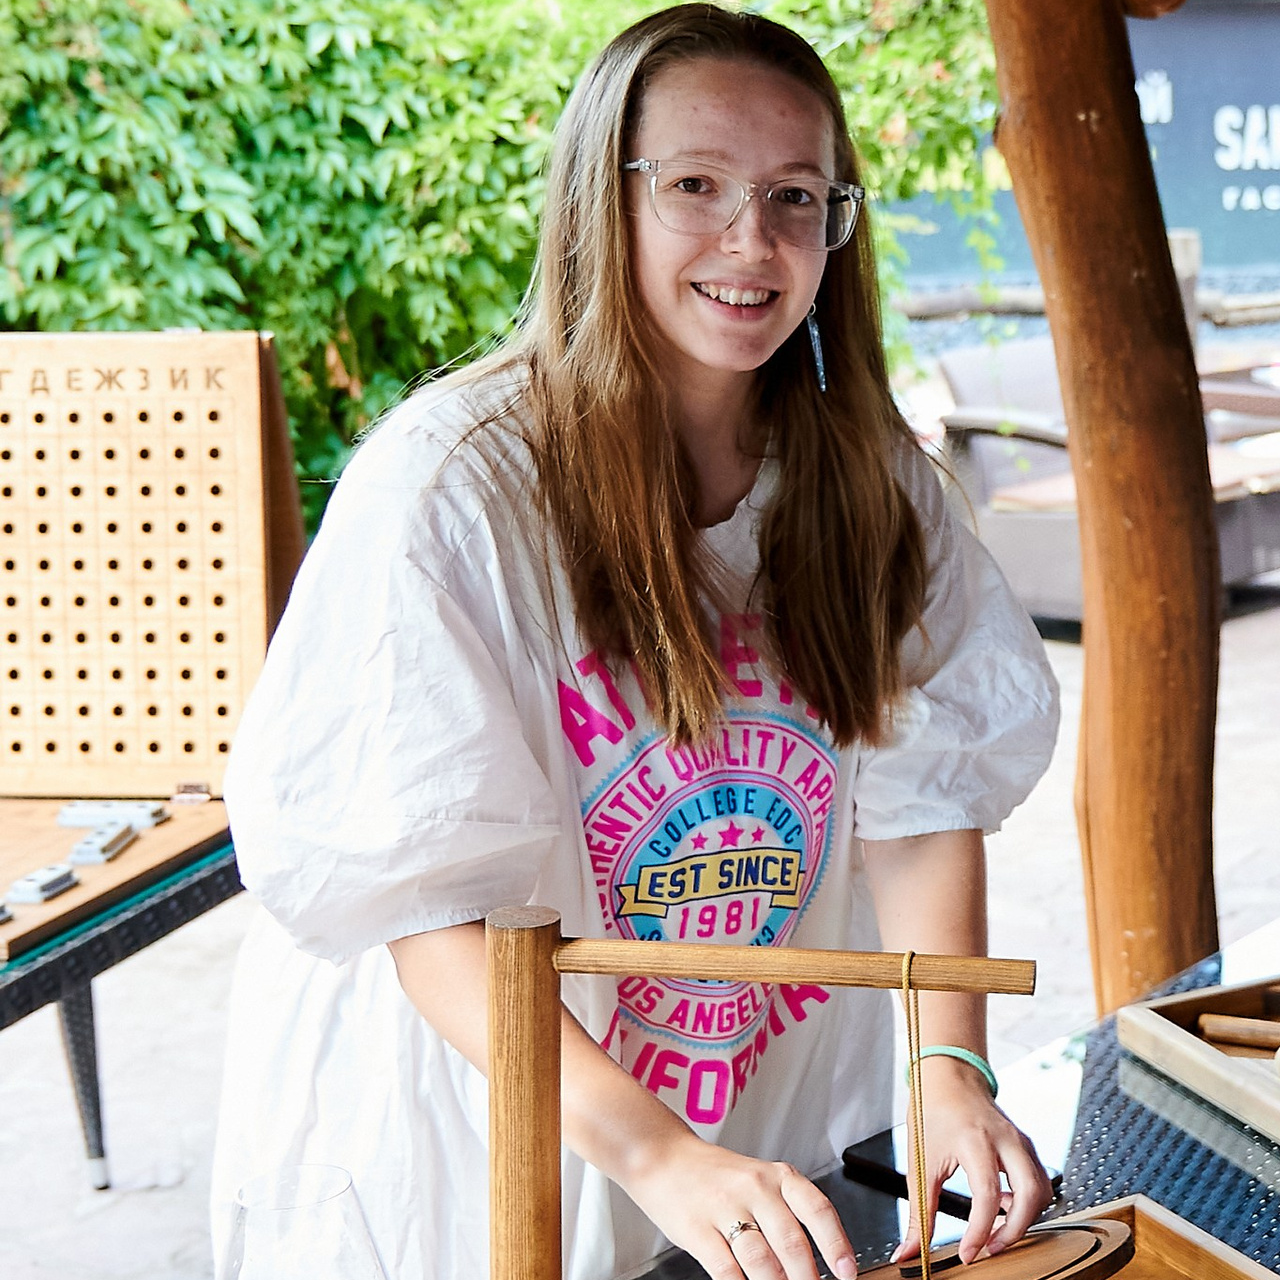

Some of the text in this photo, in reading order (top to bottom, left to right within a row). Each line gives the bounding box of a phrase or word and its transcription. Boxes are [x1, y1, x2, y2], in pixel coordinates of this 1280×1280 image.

[94, 369, 124, 391] Ж
[170, 369, 188, 391] И
[206, 368, 224, 390] К
[649, 787, 757, 858] COLLEGE
[648, 855, 794, 899] EST SINCE
[678, 897, 761, 940] 1981
[617, 975, 774, 1034] OS ANGEL
